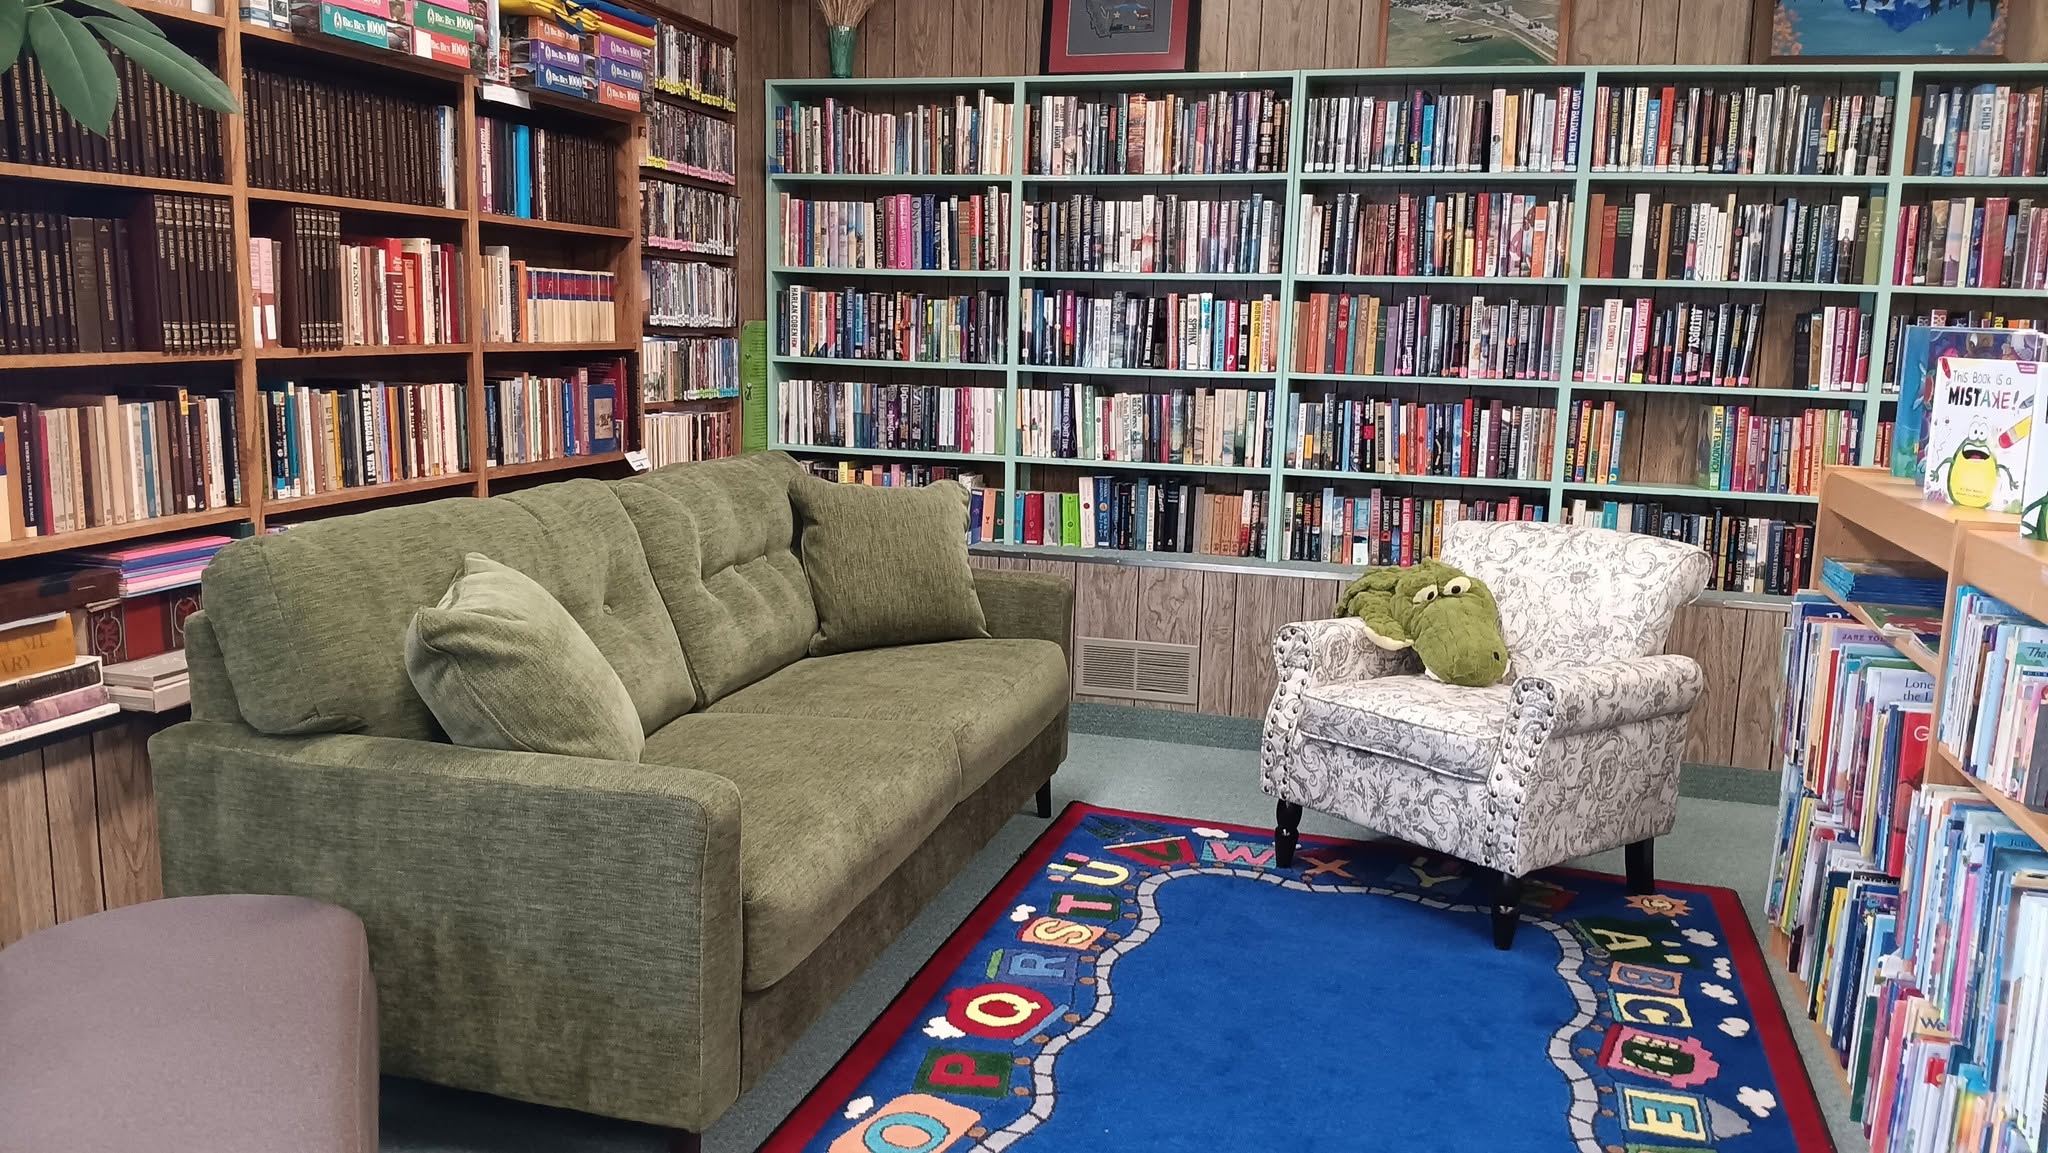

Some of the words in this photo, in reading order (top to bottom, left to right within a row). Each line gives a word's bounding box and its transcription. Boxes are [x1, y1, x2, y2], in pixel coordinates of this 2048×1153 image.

[367, 21, 386, 36] 1000
[456, 16, 474, 31] 1000
[451, 43, 467, 56] 1000
[566, 52, 579, 64] 1000
[568, 74, 582, 87] 1000
[1572, 90, 1580, 109] DAVID
[1569, 110, 1579, 142] BALDACCI
[1649, 110, 1658, 127] DAVID
[1981, 106, 1994, 131] CHILD
[1647, 128, 1656, 155] BALDACCI
[1809, 129, 1819, 146] LINER
[912, 200, 920, 228] ONYX
[1697, 214, 1706, 247] NORMAL
[1810, 218, 1819, 253] CHANGELING
[791, 287, 799, 314] HARLAN
[1608, 301, 1618, 324] PATRICIA
[1638, 302, 1649, 326] PATRICIA
[1188, 318, 1197, 345] SPHINX
[1606, 324, 1617, 351] CORNWELL
[1688, 308, 1703, 348] AUTOPSY
[1953, 370, 1968, 383] This
[1972, 372, 1991, 384] Book
[2005, 377, 2012, 385] a
[1948, 386, 2020, 411] MISTAKE!
[363, 401, 373, 451] STAGECOACH
[1523, 414, 1531, 441] EVANOVICH
[1713, 413, 1723, 433] JANET
[366, 454, 375, 476] WEST
[1711, 436, 1722, 473] EVANOVICH
[1566, 465, 1574, 476] SIX
[1736, 560, 1744, 574] SCOTT
[1734, 574, 1742, 586] FREE
[2026, 646, 2047, 659] The
[1903, 690, 1920, 702] the
[1914, 725, 1929, 742] G
[1131, 842, 1184, 863] V
[1210, 842, 1276, 864] W
[1070, 861, 1130, 886] U
[1301, 856, 1355, 878] X
[1410, 865, 1460, 887] Y
[1056, 895, 1112, 914] T
[1033, 919, 1093, 945] S
[1591, 928, 1652, 951] A
[1008, 953, 1066, 978] R
[1618, 966, 1674, 990] B
[965, 992, 1040, 1026] Q
[1623, 999, 1684, 1026] C
[928, 1054, 1000, 1088] P
[1630, 1095, 1698, 1133] E
[864, 1111, 950, 1153] O
